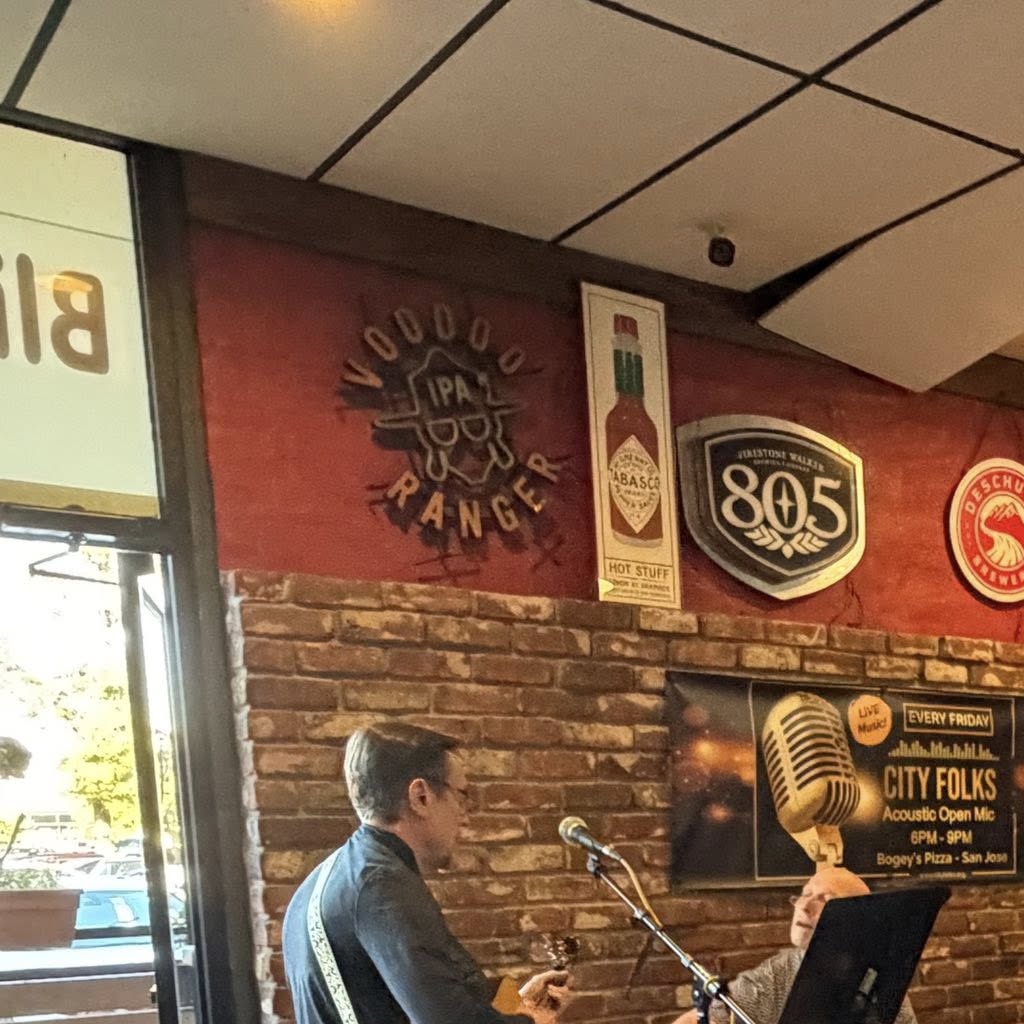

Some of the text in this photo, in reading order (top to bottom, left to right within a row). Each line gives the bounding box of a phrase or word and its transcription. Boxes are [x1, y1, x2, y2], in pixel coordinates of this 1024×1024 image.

[342, 303, 526, 389] VOODOO
[427, 374, 472, 407] IPA
[609, 468, 661, 491] TABASCO
[386, 452, 562, 538] RANGER
[720, 463, 848, 540] 805
[608, 560, 671, 580] HOT STUFF
[858, 703, 881, 719] LIVE
[908, 709, 990, 728] EVERY FRIDAY
[884, 764, 998, 801] CITY FOLKS
[882, 805, 995, 825] Acoustic Open Mic
[946, 830, 973, 845] 9PM
[876, 851, 923, 869] Bogey's
[924, 851, 953, 865] Pizza
[961, 850, 983, 864] San
